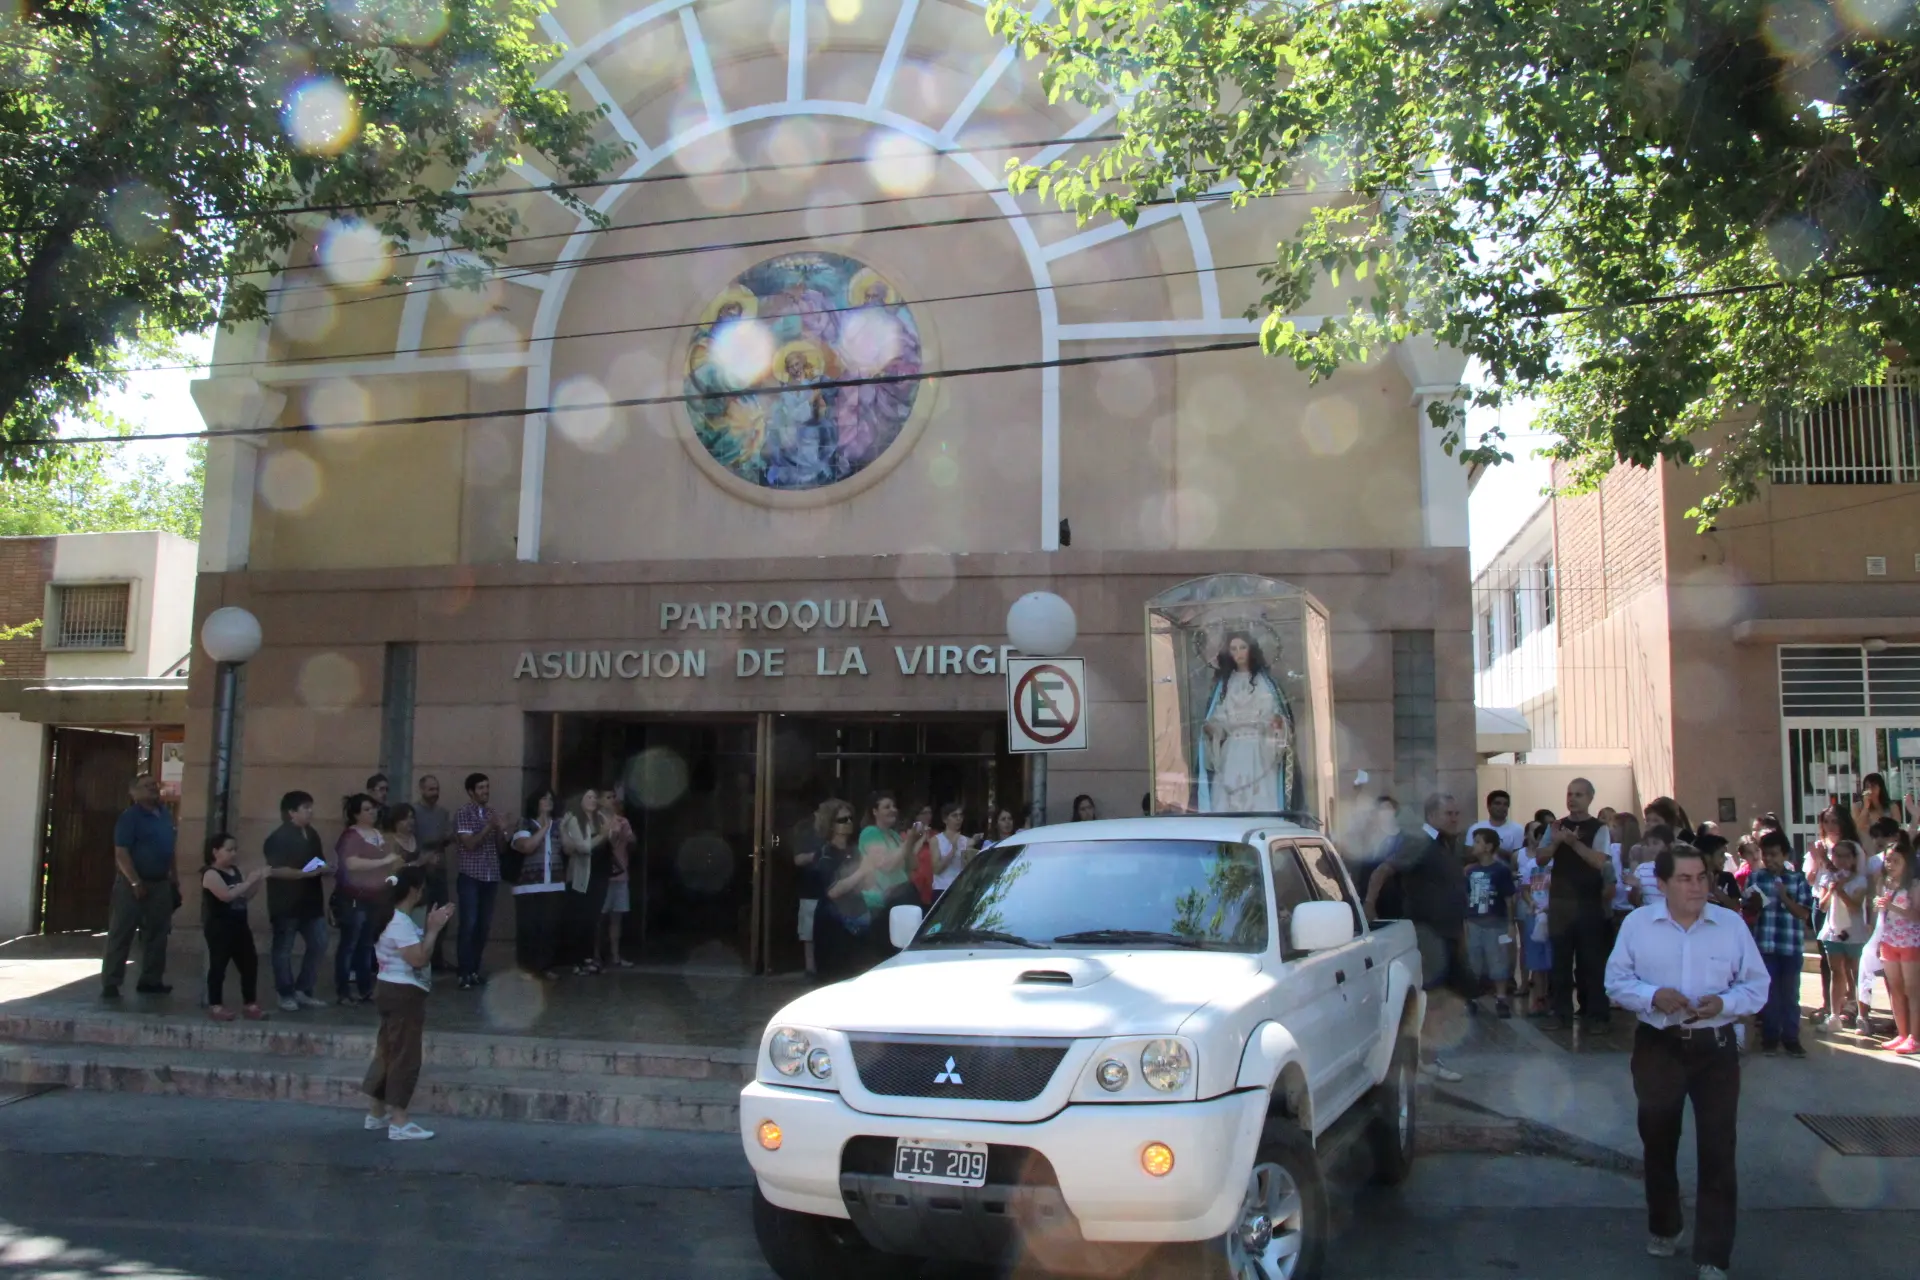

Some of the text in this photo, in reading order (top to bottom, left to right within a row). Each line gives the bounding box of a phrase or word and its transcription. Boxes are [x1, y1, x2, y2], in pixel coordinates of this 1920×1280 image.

[659, 598, 891, 633] PARROQUIA
[513, 649, 706, 680] ASUNCION
[736, 648, 785, 678] DE
[816, 646, 869, 676] LA
[1030, 681, 1065, 728] E
[898, 1147, 984, 1179] FIS 209
